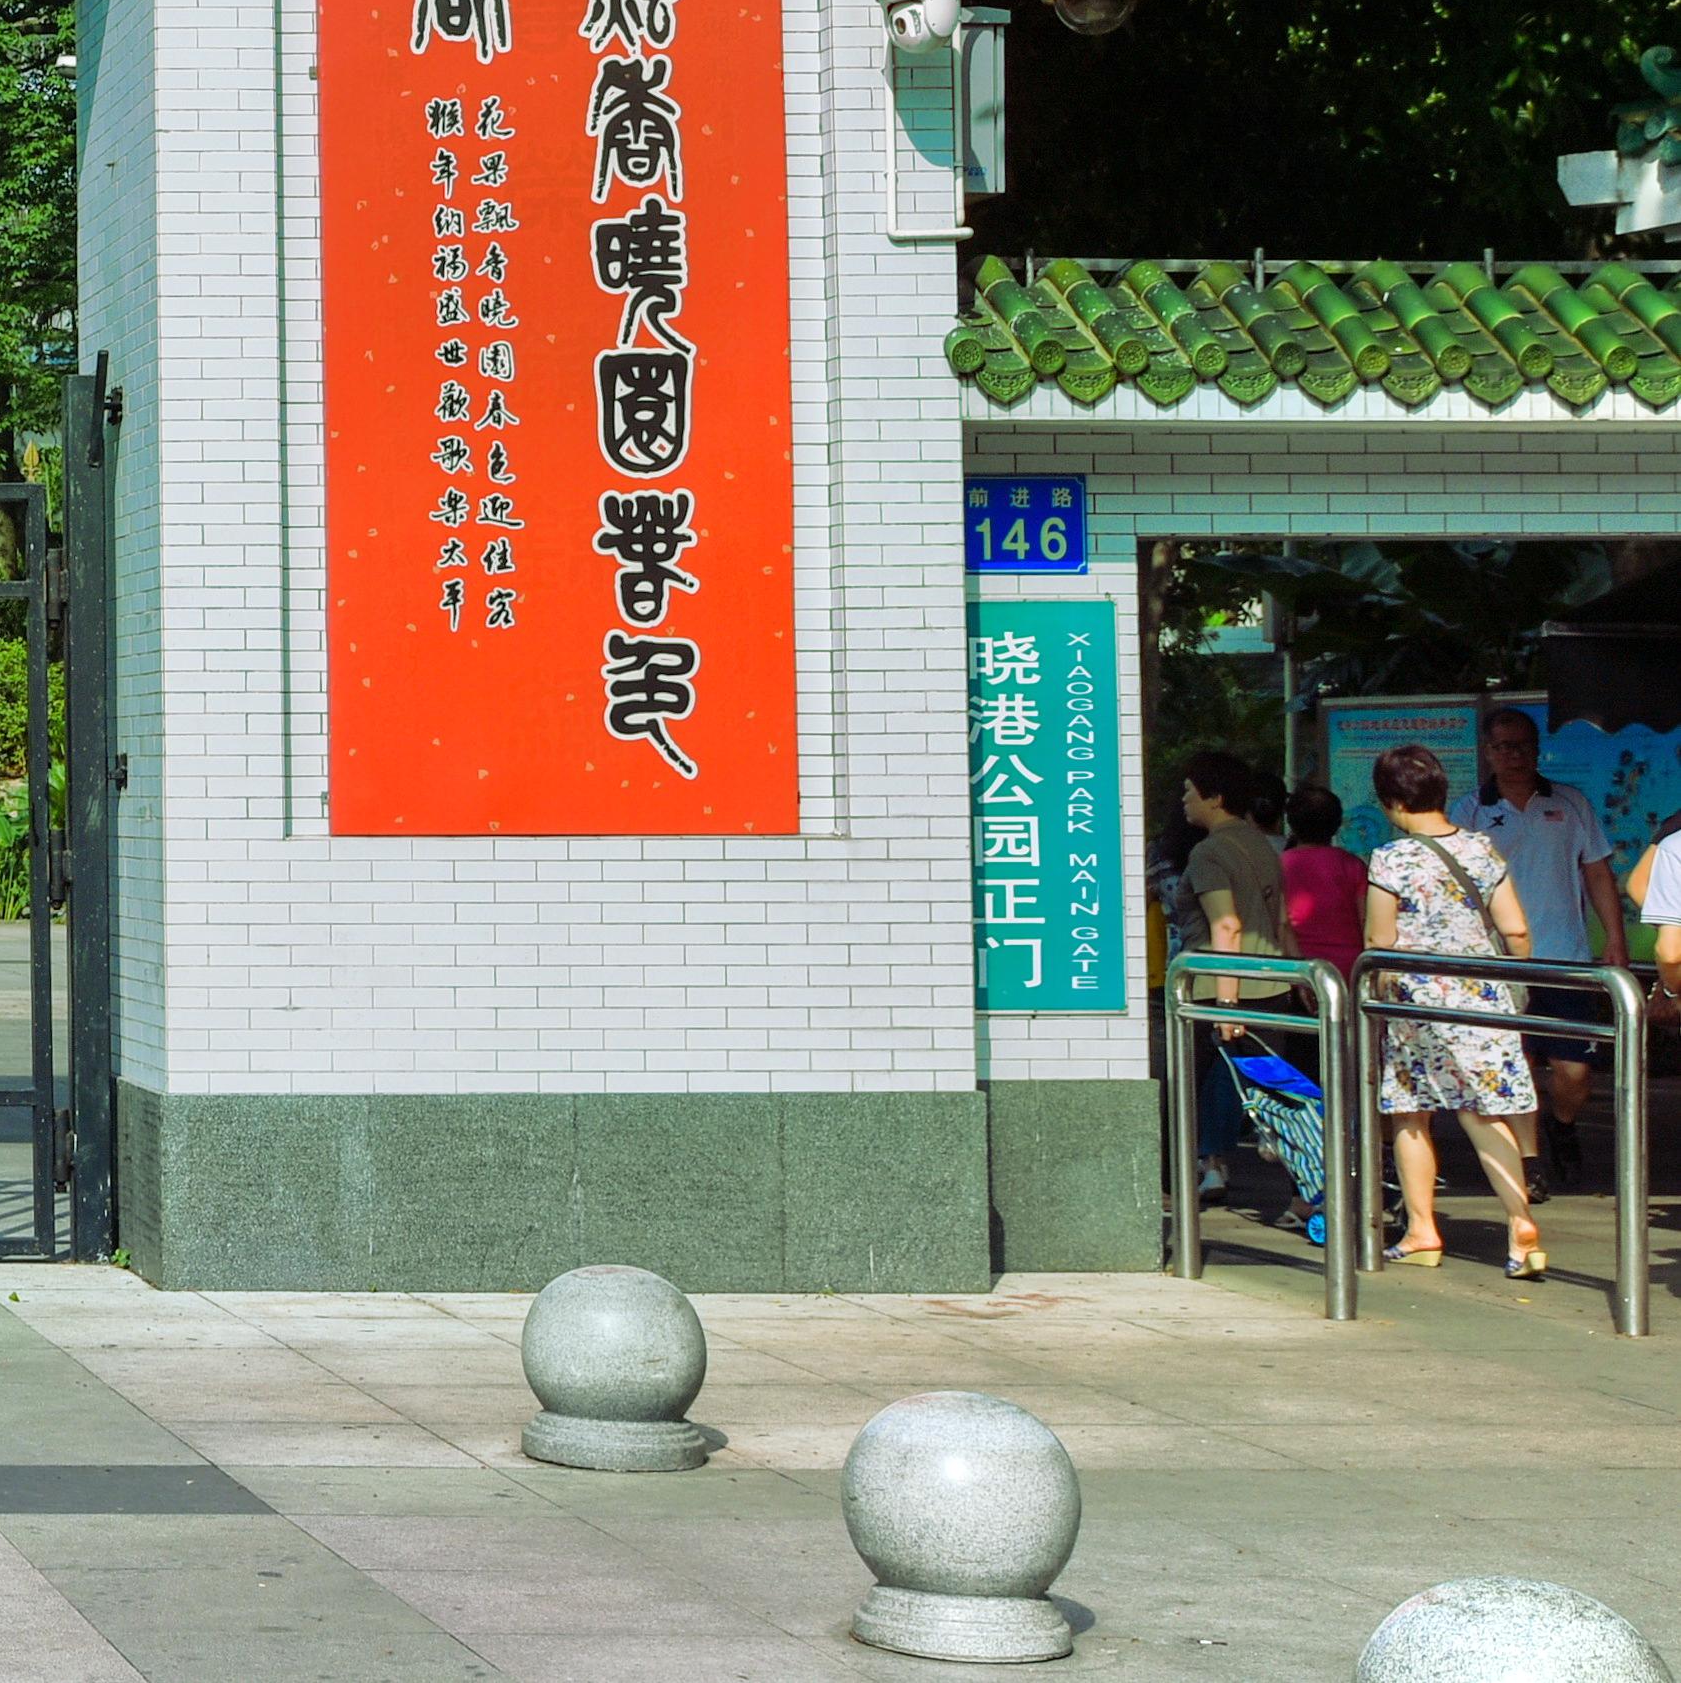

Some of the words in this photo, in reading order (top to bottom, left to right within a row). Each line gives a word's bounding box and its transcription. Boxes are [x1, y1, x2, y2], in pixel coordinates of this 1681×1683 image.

[968, 488, 1072, 508] 前进路
[975, 517, 1067, 561] 146
[1066, 633, 1095, 760] XIAOGANG
[968, 632, 1046, 989] 晓港公园正门
[1067, 771, 1095, 833] PARK
[1069, 854, 1099, 916] MAIN
[1071, 926, 1099, 989] GATE
